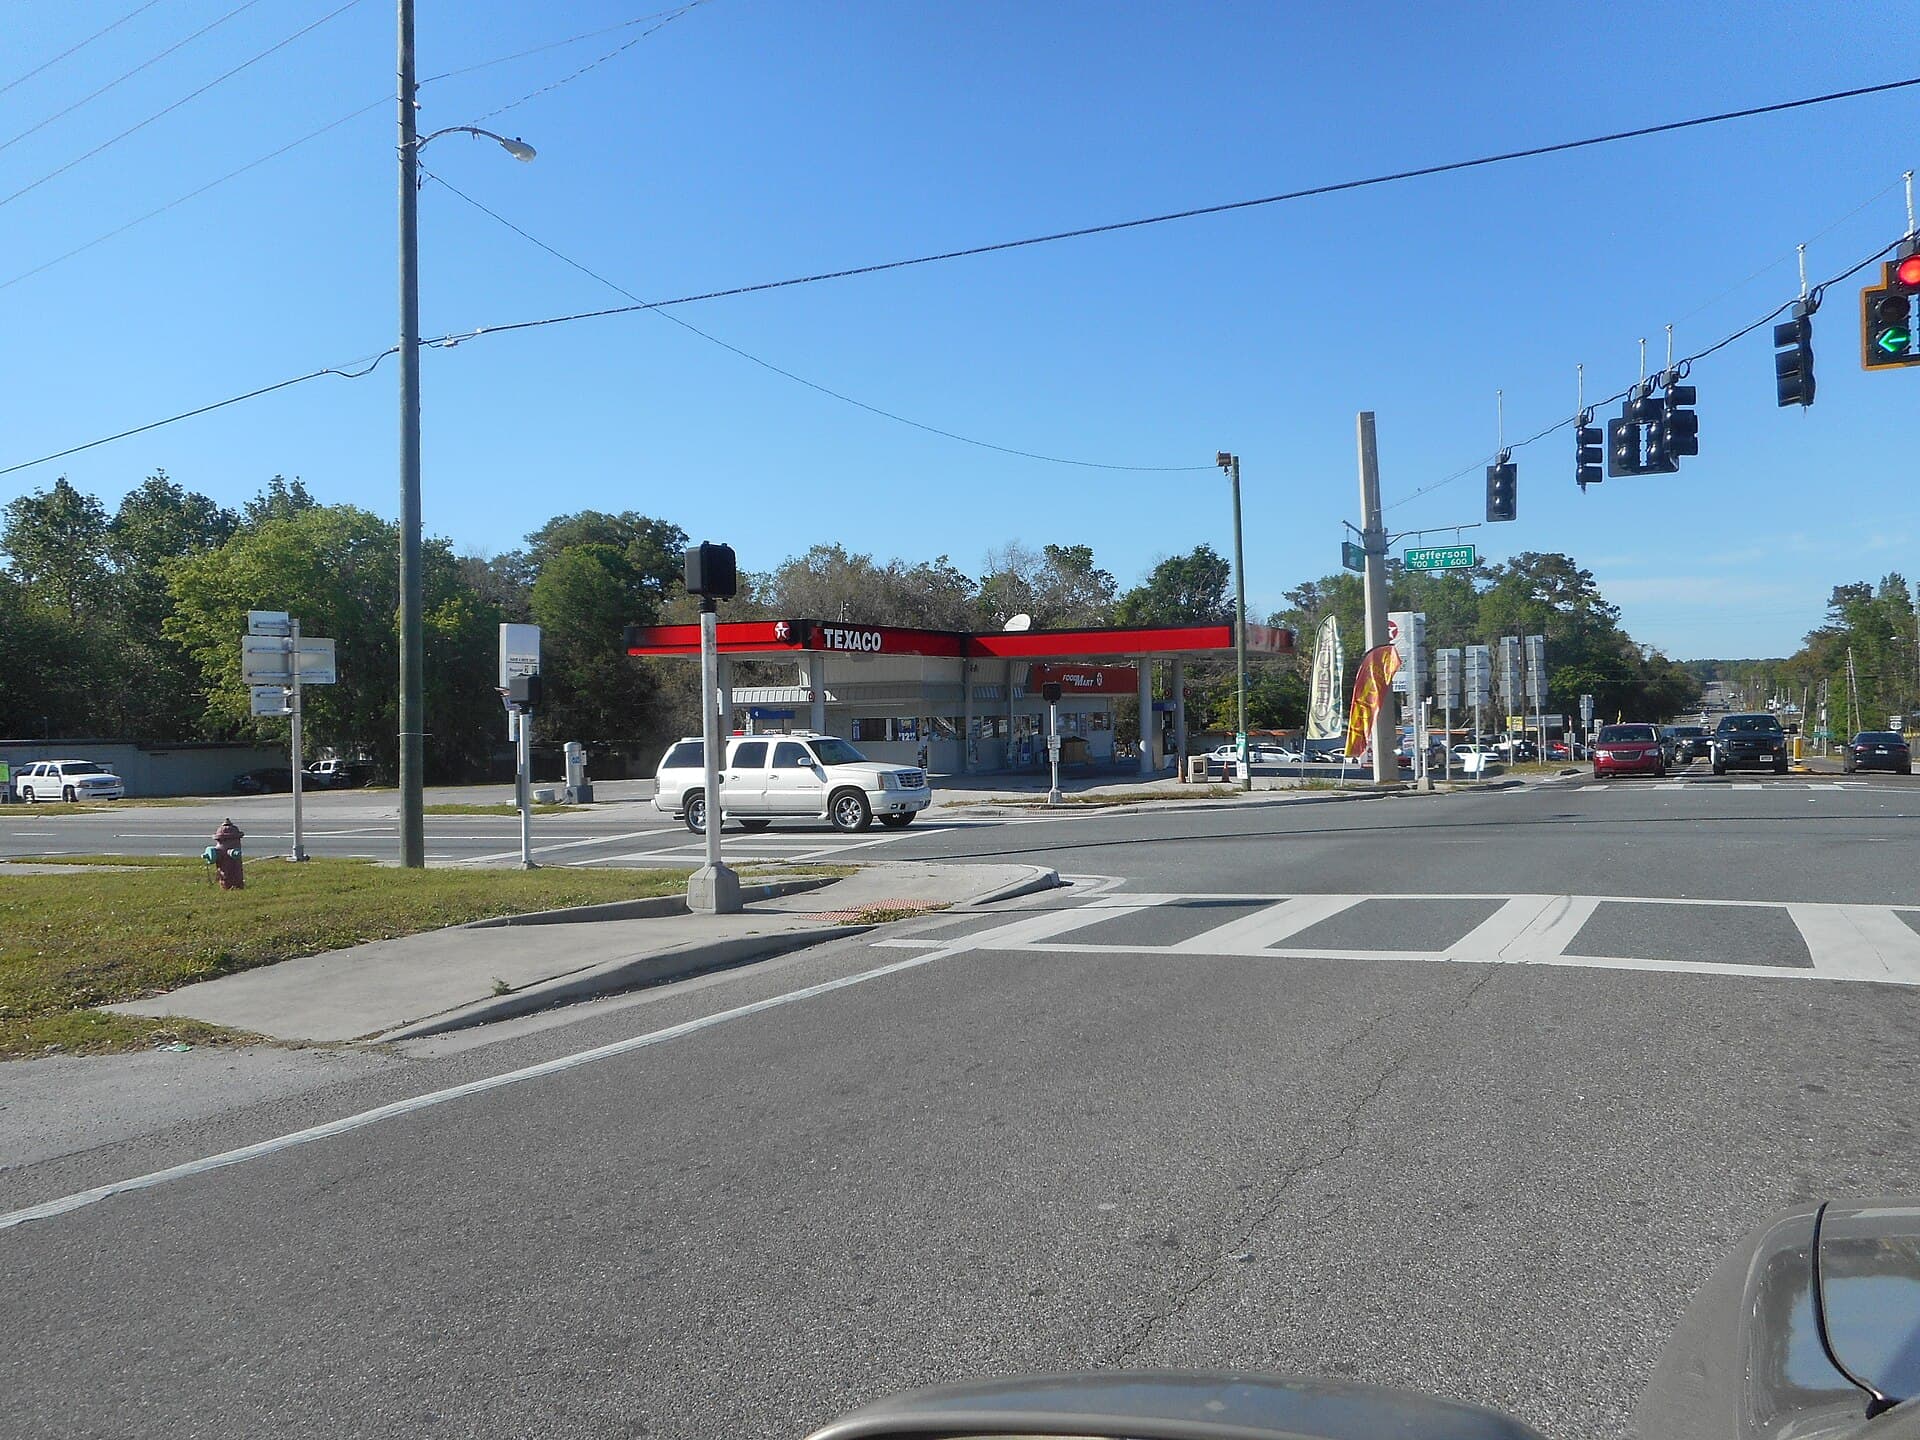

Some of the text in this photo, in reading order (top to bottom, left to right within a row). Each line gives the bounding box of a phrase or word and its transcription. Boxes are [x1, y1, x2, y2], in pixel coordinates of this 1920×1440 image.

[1411, 550, 1467, 560] Jefferson
[1450, 558, 1467, 566] 600
[824, 628, 881, 652] TEXACO
